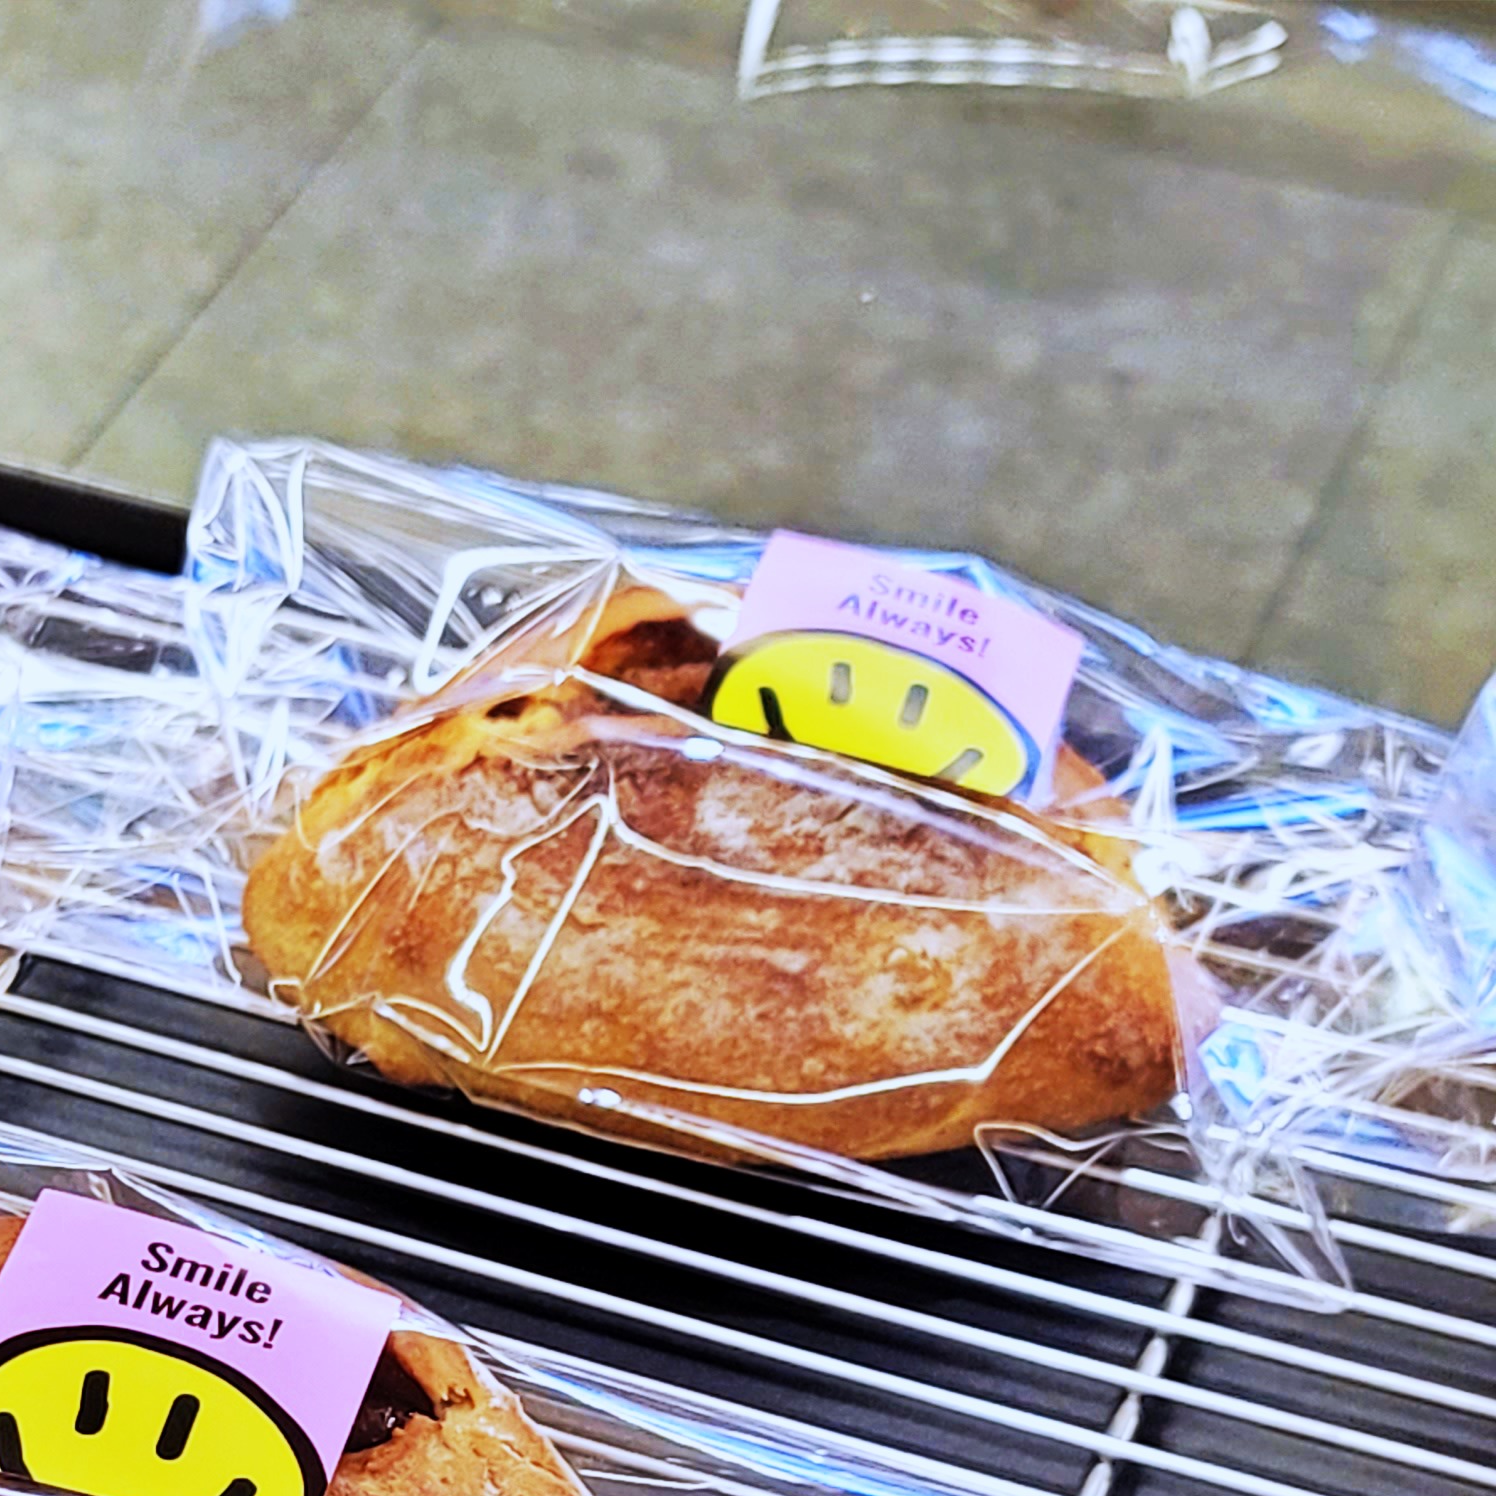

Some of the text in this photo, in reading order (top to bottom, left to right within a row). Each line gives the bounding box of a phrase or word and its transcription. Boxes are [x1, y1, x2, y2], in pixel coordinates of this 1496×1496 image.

[838, 593, 992, 658] Always!
[868, 573, 980, 625] Smile
[141, 1241, 273, 1304] Smile
[98, 1272, 284, 1349] Always!
